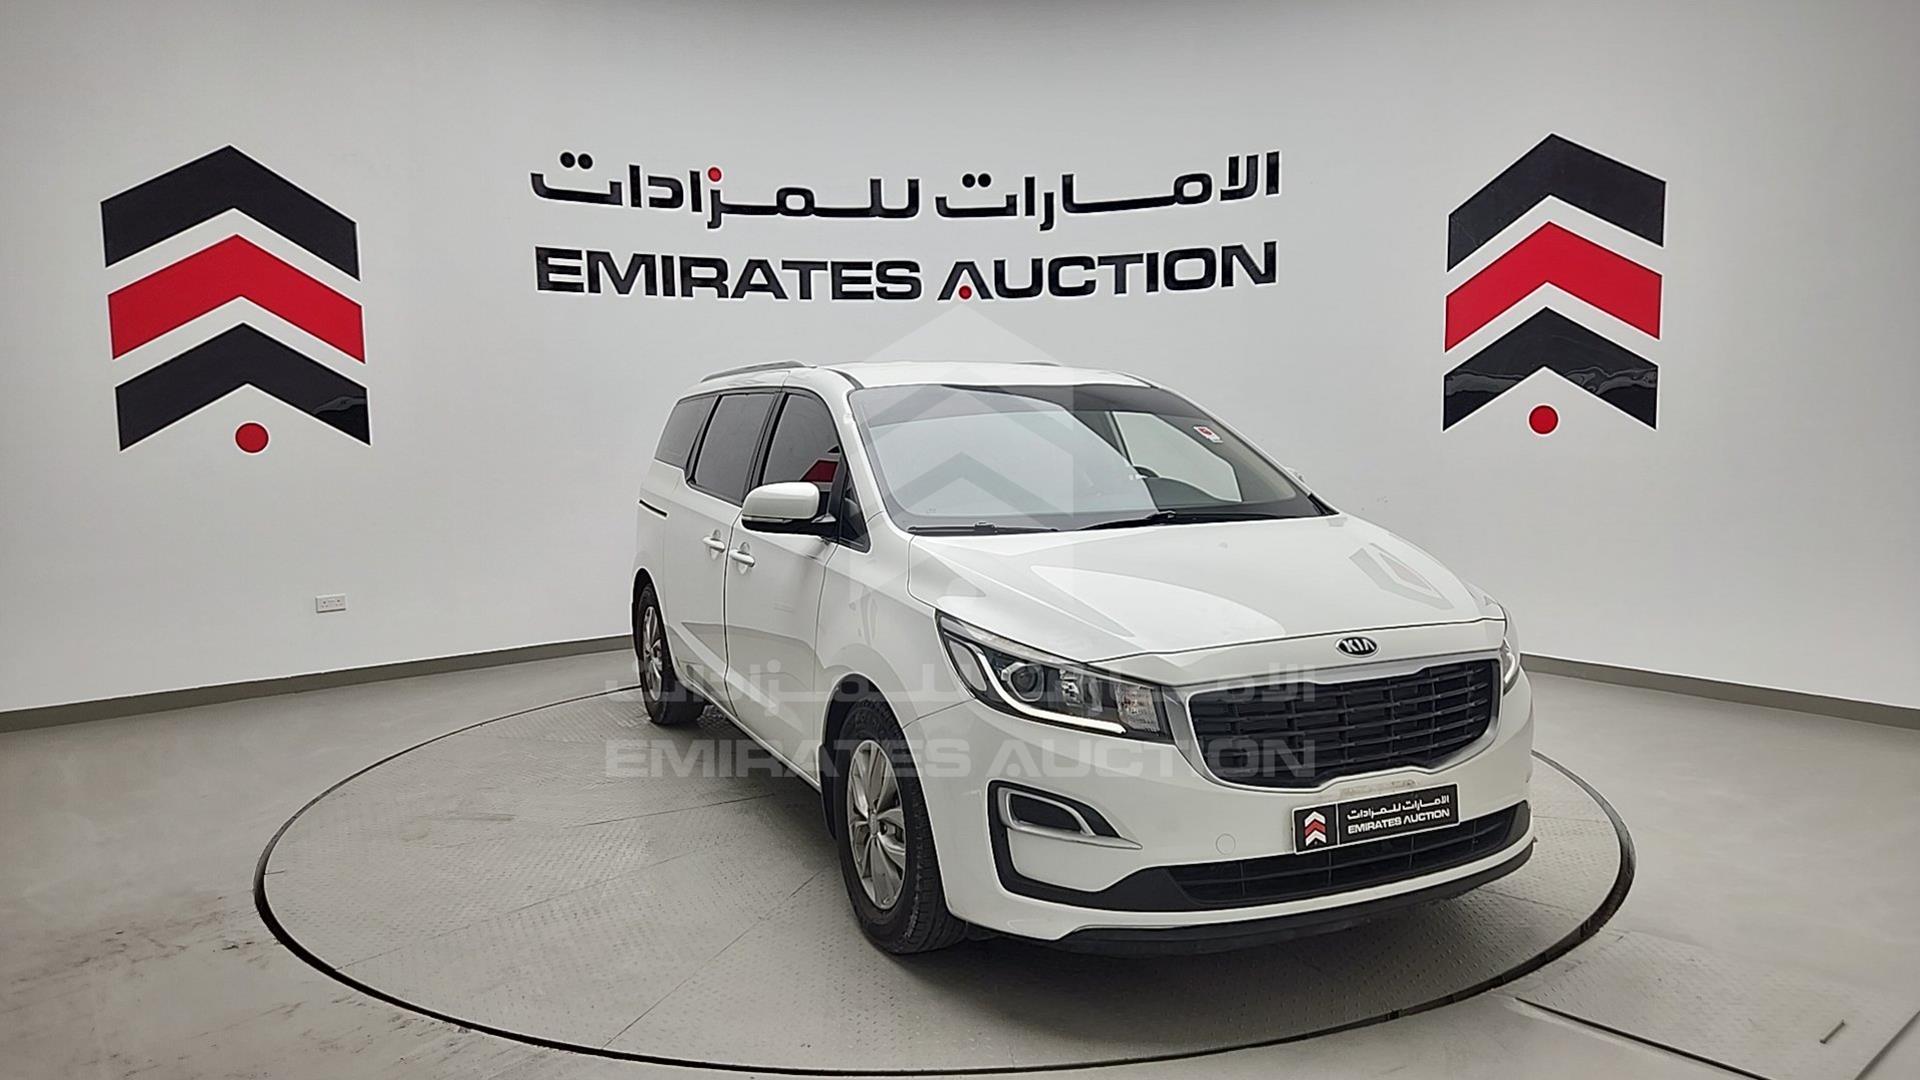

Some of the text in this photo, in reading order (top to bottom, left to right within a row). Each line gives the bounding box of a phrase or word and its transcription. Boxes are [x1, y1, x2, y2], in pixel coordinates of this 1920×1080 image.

[535, 241, 1277, 300] EMIRATES AUCTION
[1342, 638, 1375, 652] KIA
[1348, 808, 1450, 834] EMIRATES AUCTION
